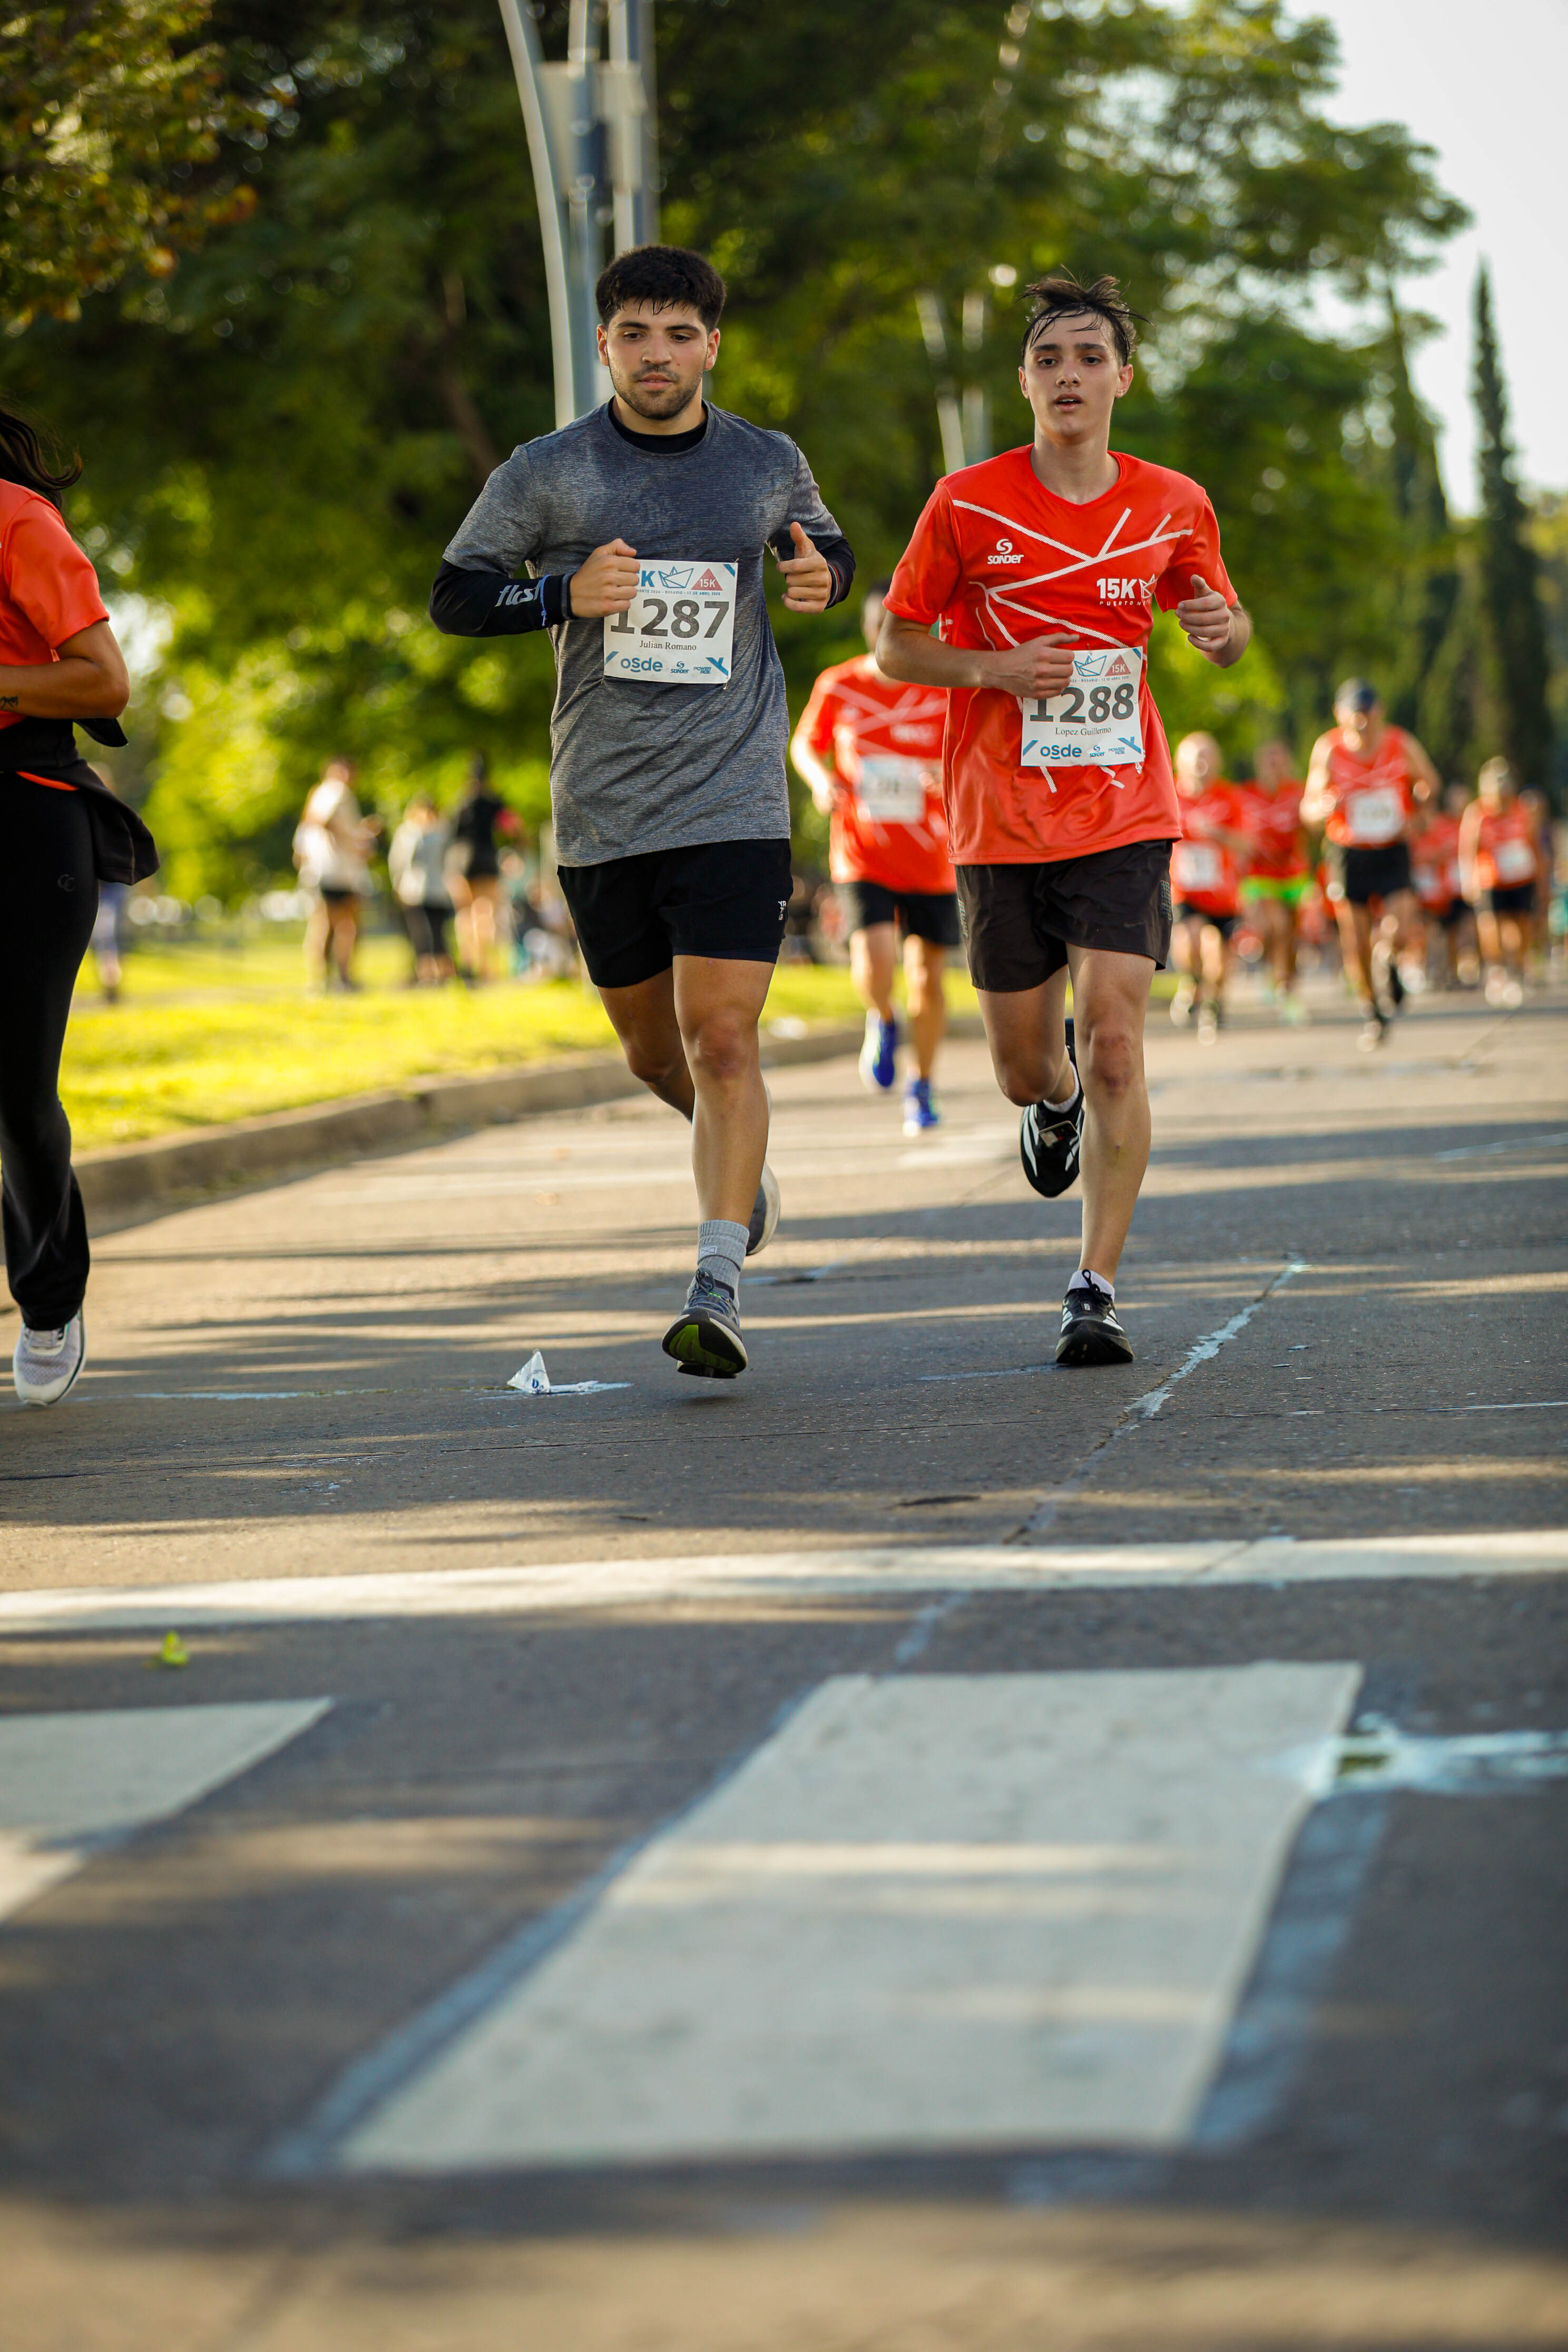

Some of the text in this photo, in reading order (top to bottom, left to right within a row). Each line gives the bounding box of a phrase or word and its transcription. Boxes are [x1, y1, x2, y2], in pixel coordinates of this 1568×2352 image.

[699, 579, 716, 588] 15K
[1096, 578, 1138, 599] 15K
[611, 599, 730, 639] 1287
[640, 640, 697, 650] Julian Romano
[620, 657, 663, 672] osde
[1112, 664, 1125, 673] 15K
[1030, 683, 1134, 723] 1288
[1055, 727, 1112, 737] Lopez Guillermo
[1040, 743, 1082, 759] osde
